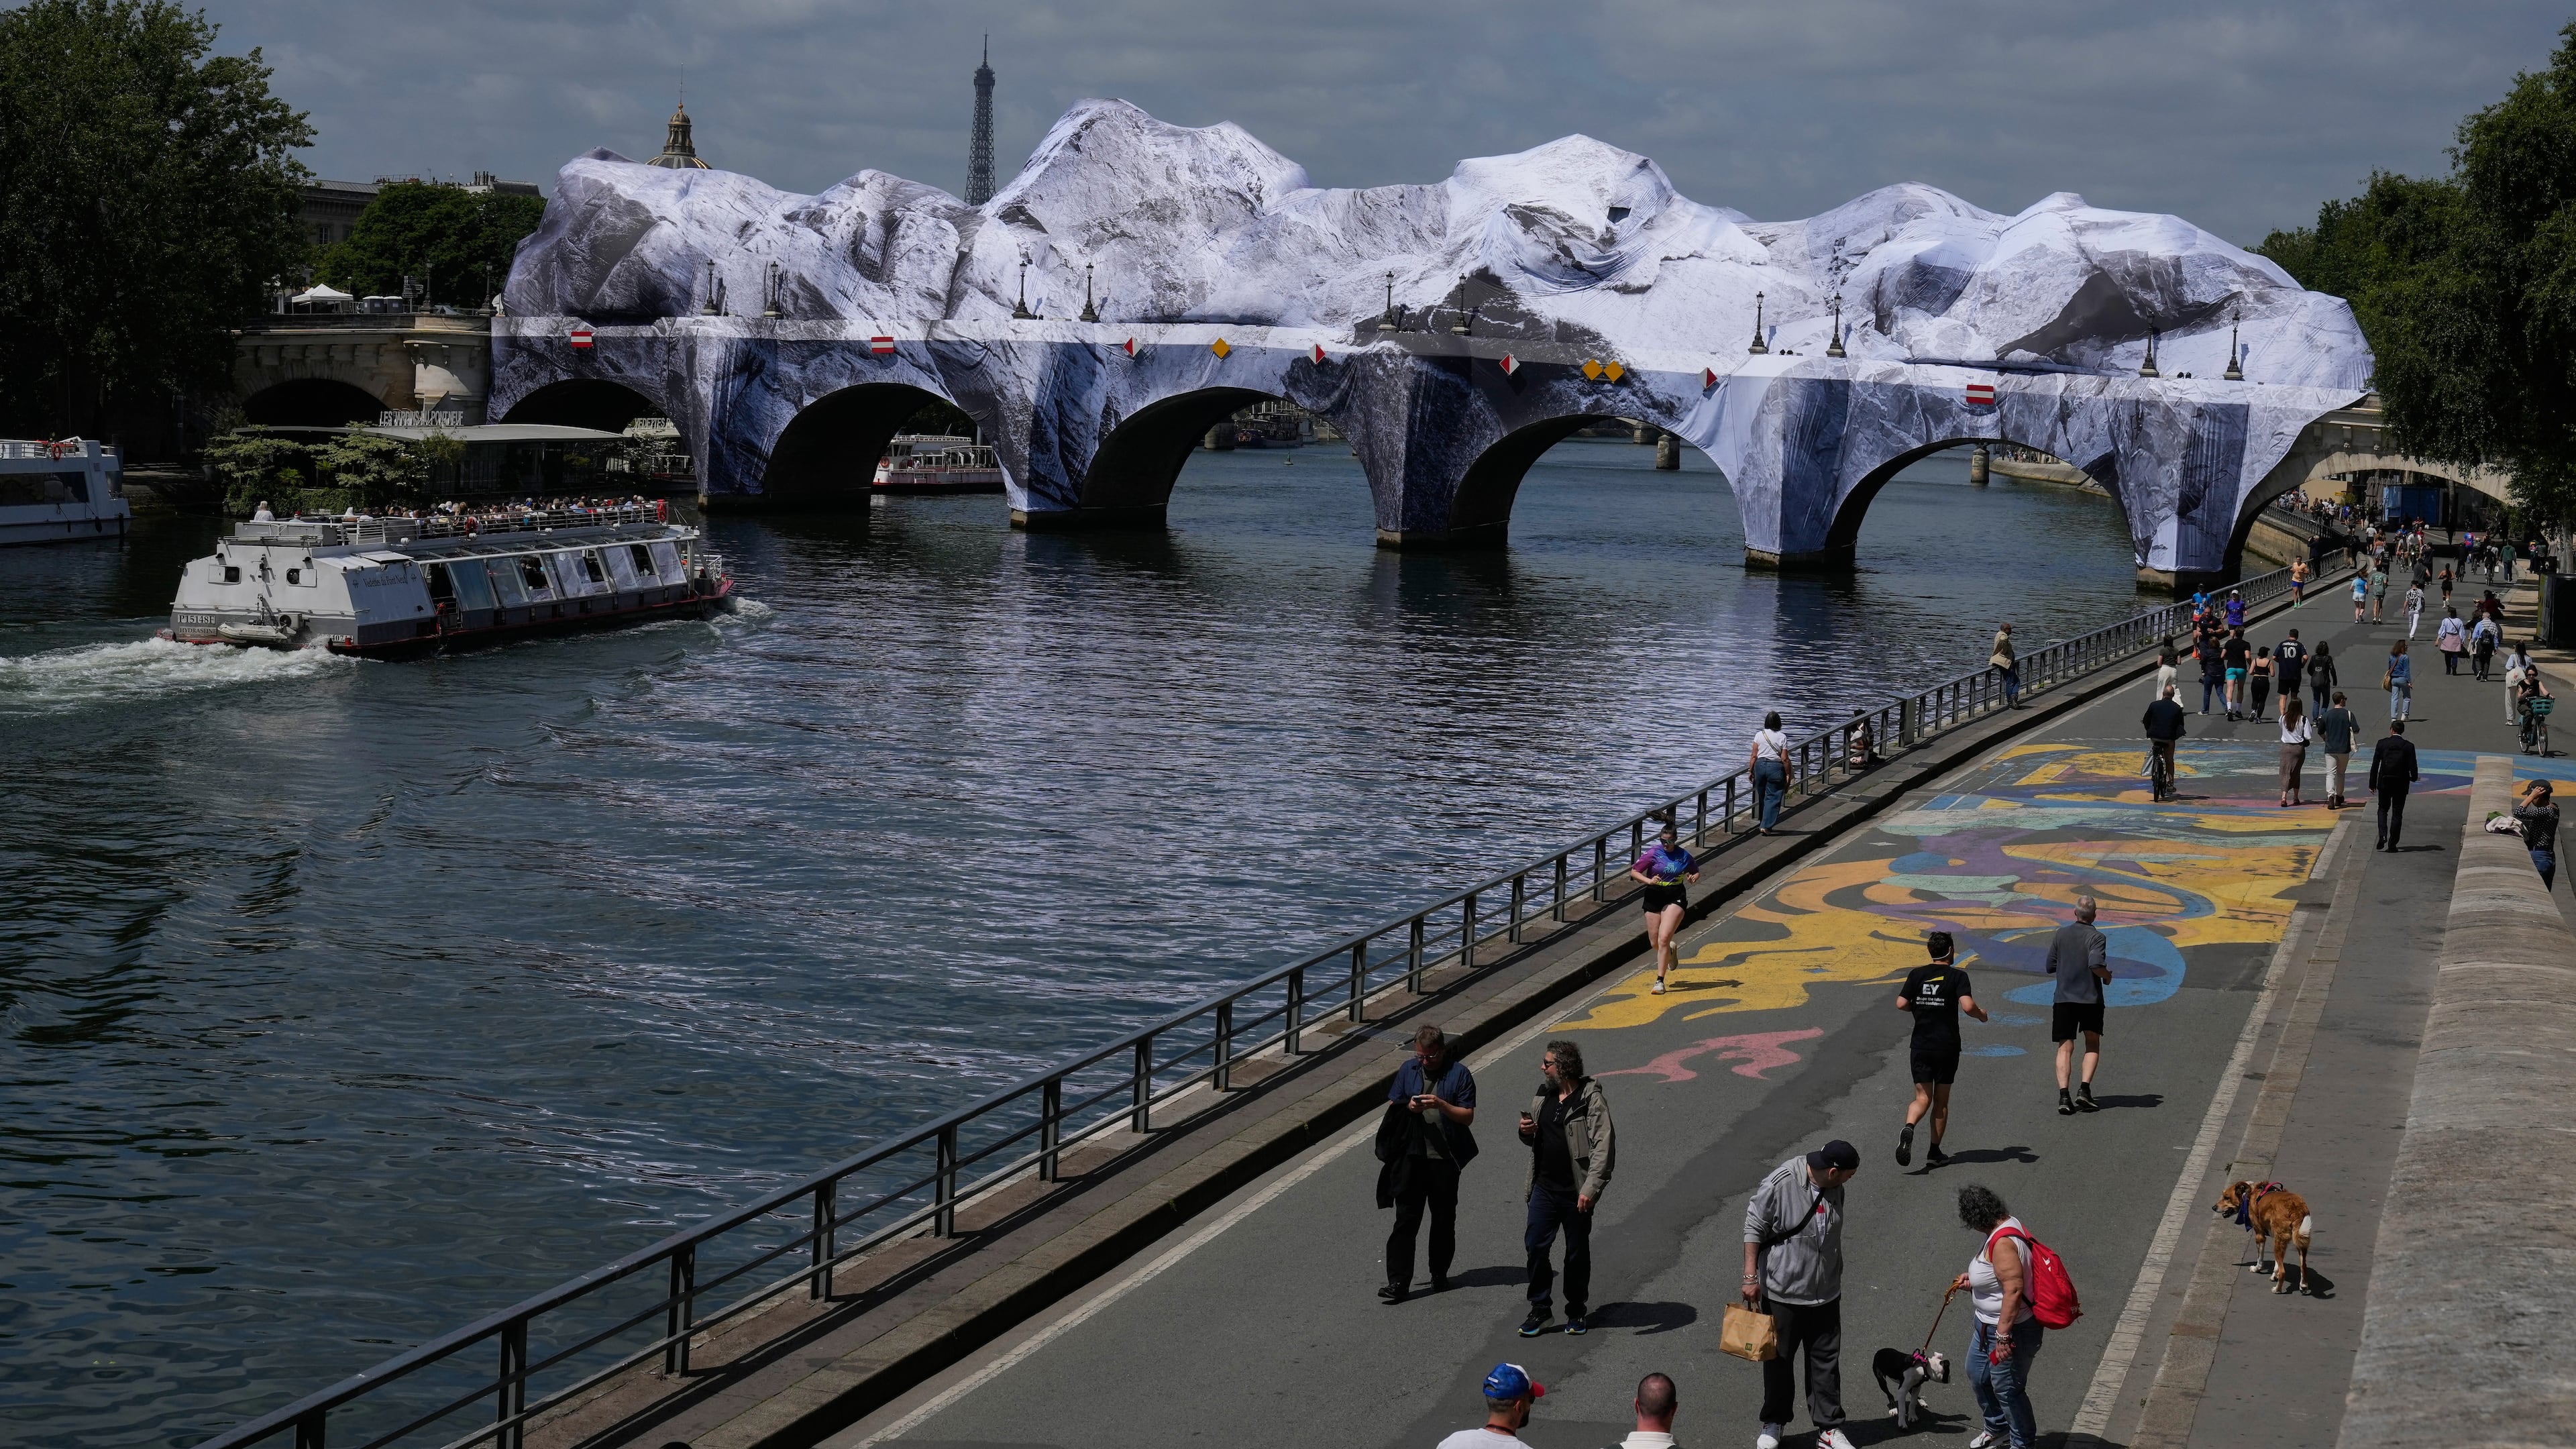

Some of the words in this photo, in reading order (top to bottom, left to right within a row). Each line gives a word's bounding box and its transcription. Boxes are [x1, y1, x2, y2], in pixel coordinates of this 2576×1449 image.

[379, 411, 393, 425] LES
[394, 411, 419, 425] JARDINS
[421, 411, 429, 425] DU
[431, 411, 448, 425] PONT
[448, 411, 464, 425] NEUF
[634, 418, 665, 429] VEDETTES
[363, 578, 382, 588] Vedettes
[381, 576, 387, 586] du
[386, 576, 396, 586] Pont
[395, 574, 408, 585] Neuf
[179, 615, 215, 623] P15148F
[2283, 646, 2297, 659] 10
[1923, 983, 1940, 996] EY
